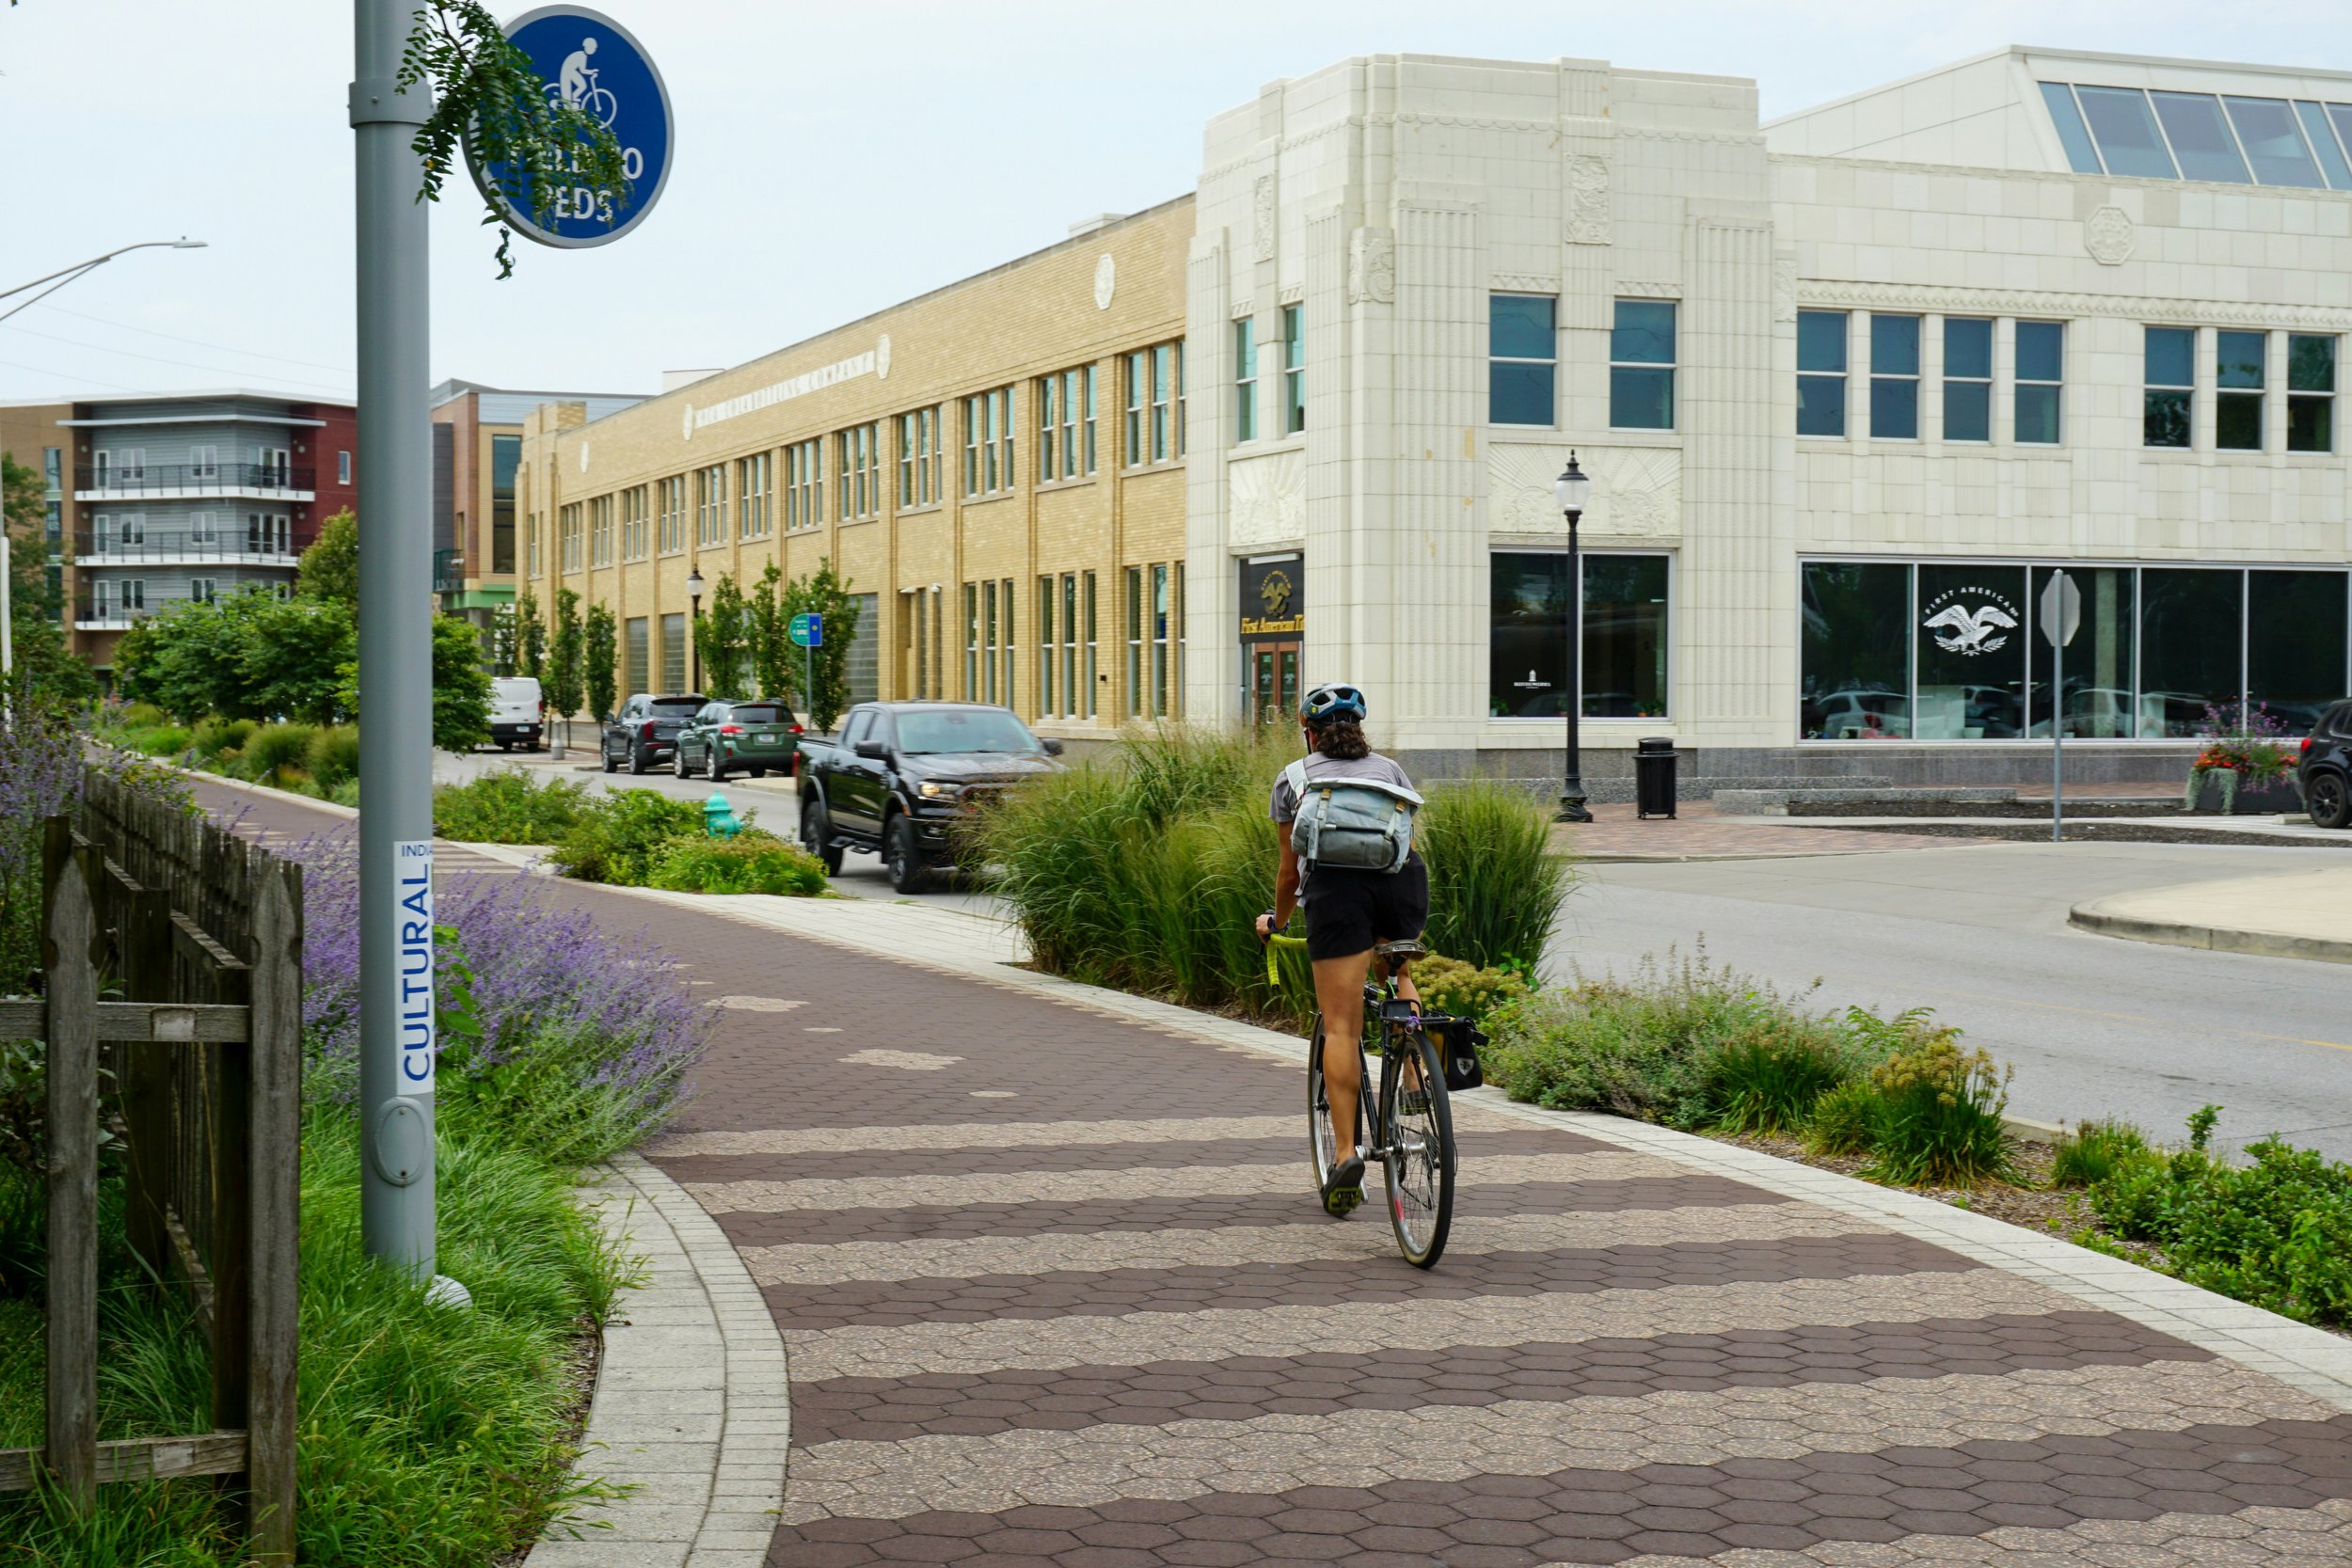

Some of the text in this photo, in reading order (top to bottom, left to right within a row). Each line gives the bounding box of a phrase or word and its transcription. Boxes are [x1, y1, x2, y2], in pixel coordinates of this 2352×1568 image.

[808, 356, 867, 390] COMPANY
[1925, 587, 2017, 616] FIRST AMERICAN
[402, 863, 432, 1081] CULTURAL
